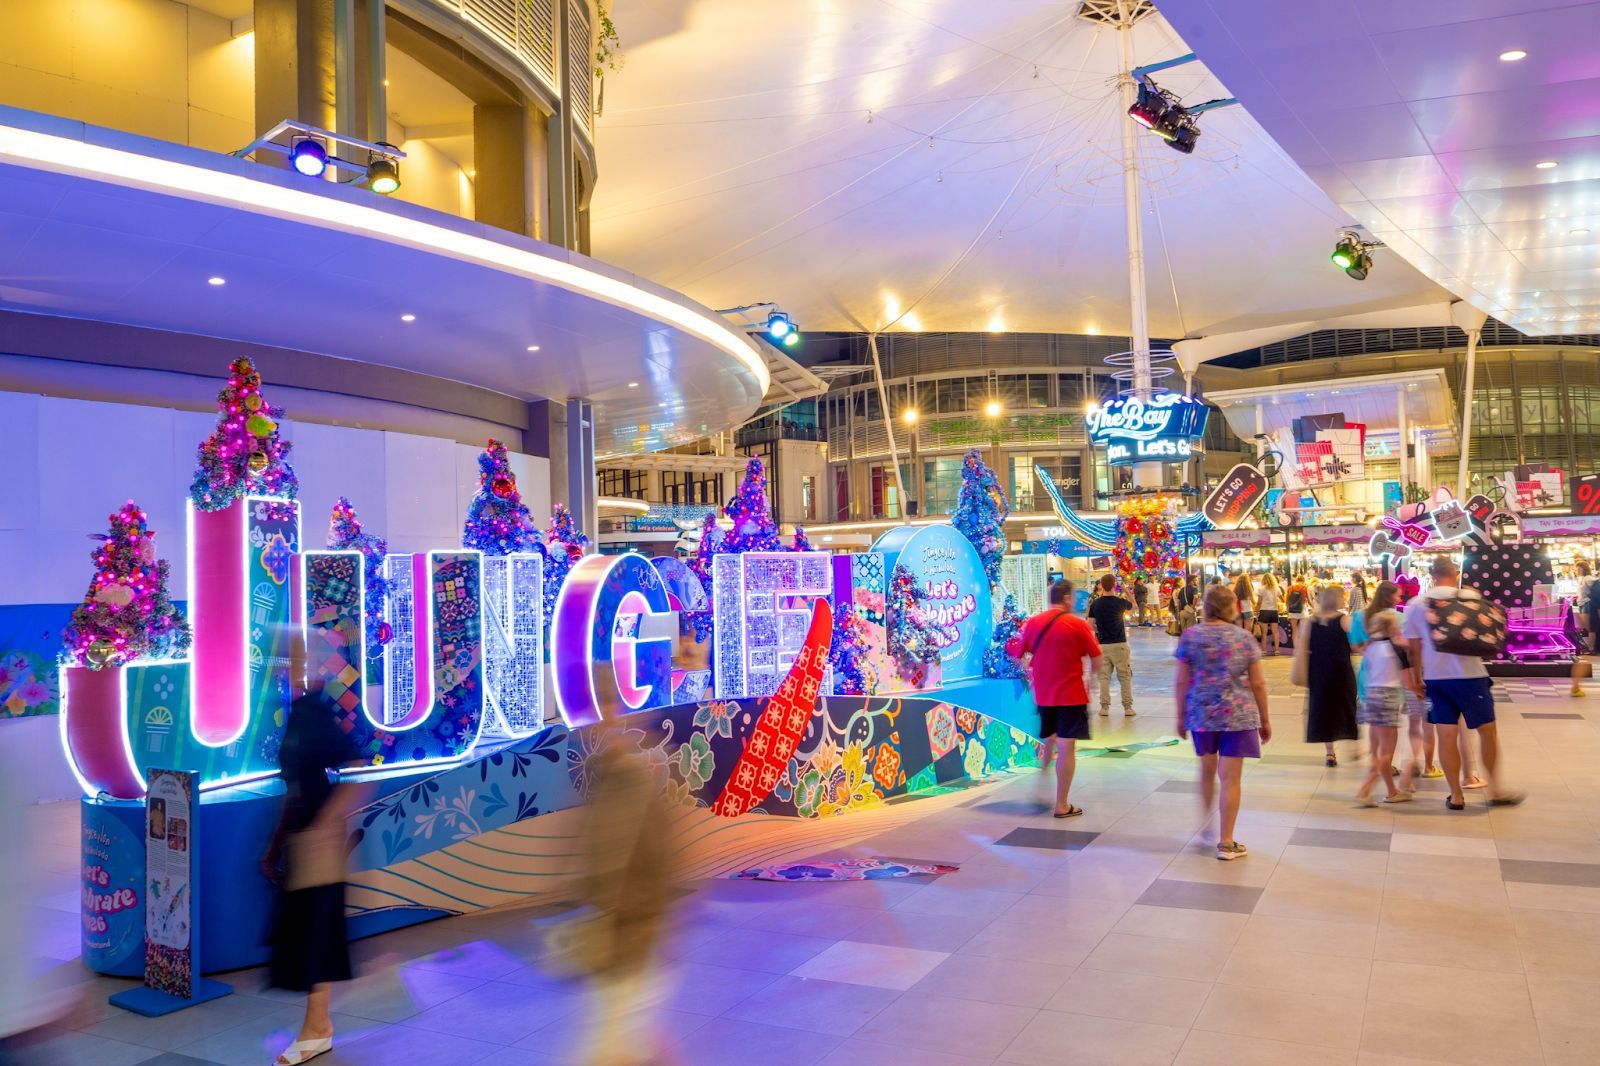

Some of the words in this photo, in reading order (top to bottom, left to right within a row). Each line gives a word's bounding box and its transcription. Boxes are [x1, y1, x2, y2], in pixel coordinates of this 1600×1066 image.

[1086, 402, 1122, 434] The
[1121, 397, 1172, 433] Bay
[1137, 440, 1177, 456] Let's
[1051, 477, 1081, 490] rangler
[1213, 488, 1234, 513] LET'S
[1229, 478, 1244, 490] GO
[1406, 527, 1426, 543] SALE
[925, 579, 959, 601] Let's
[925, 594, 977, 627] lebrate
[82, 884, 138, 914] ebrate
